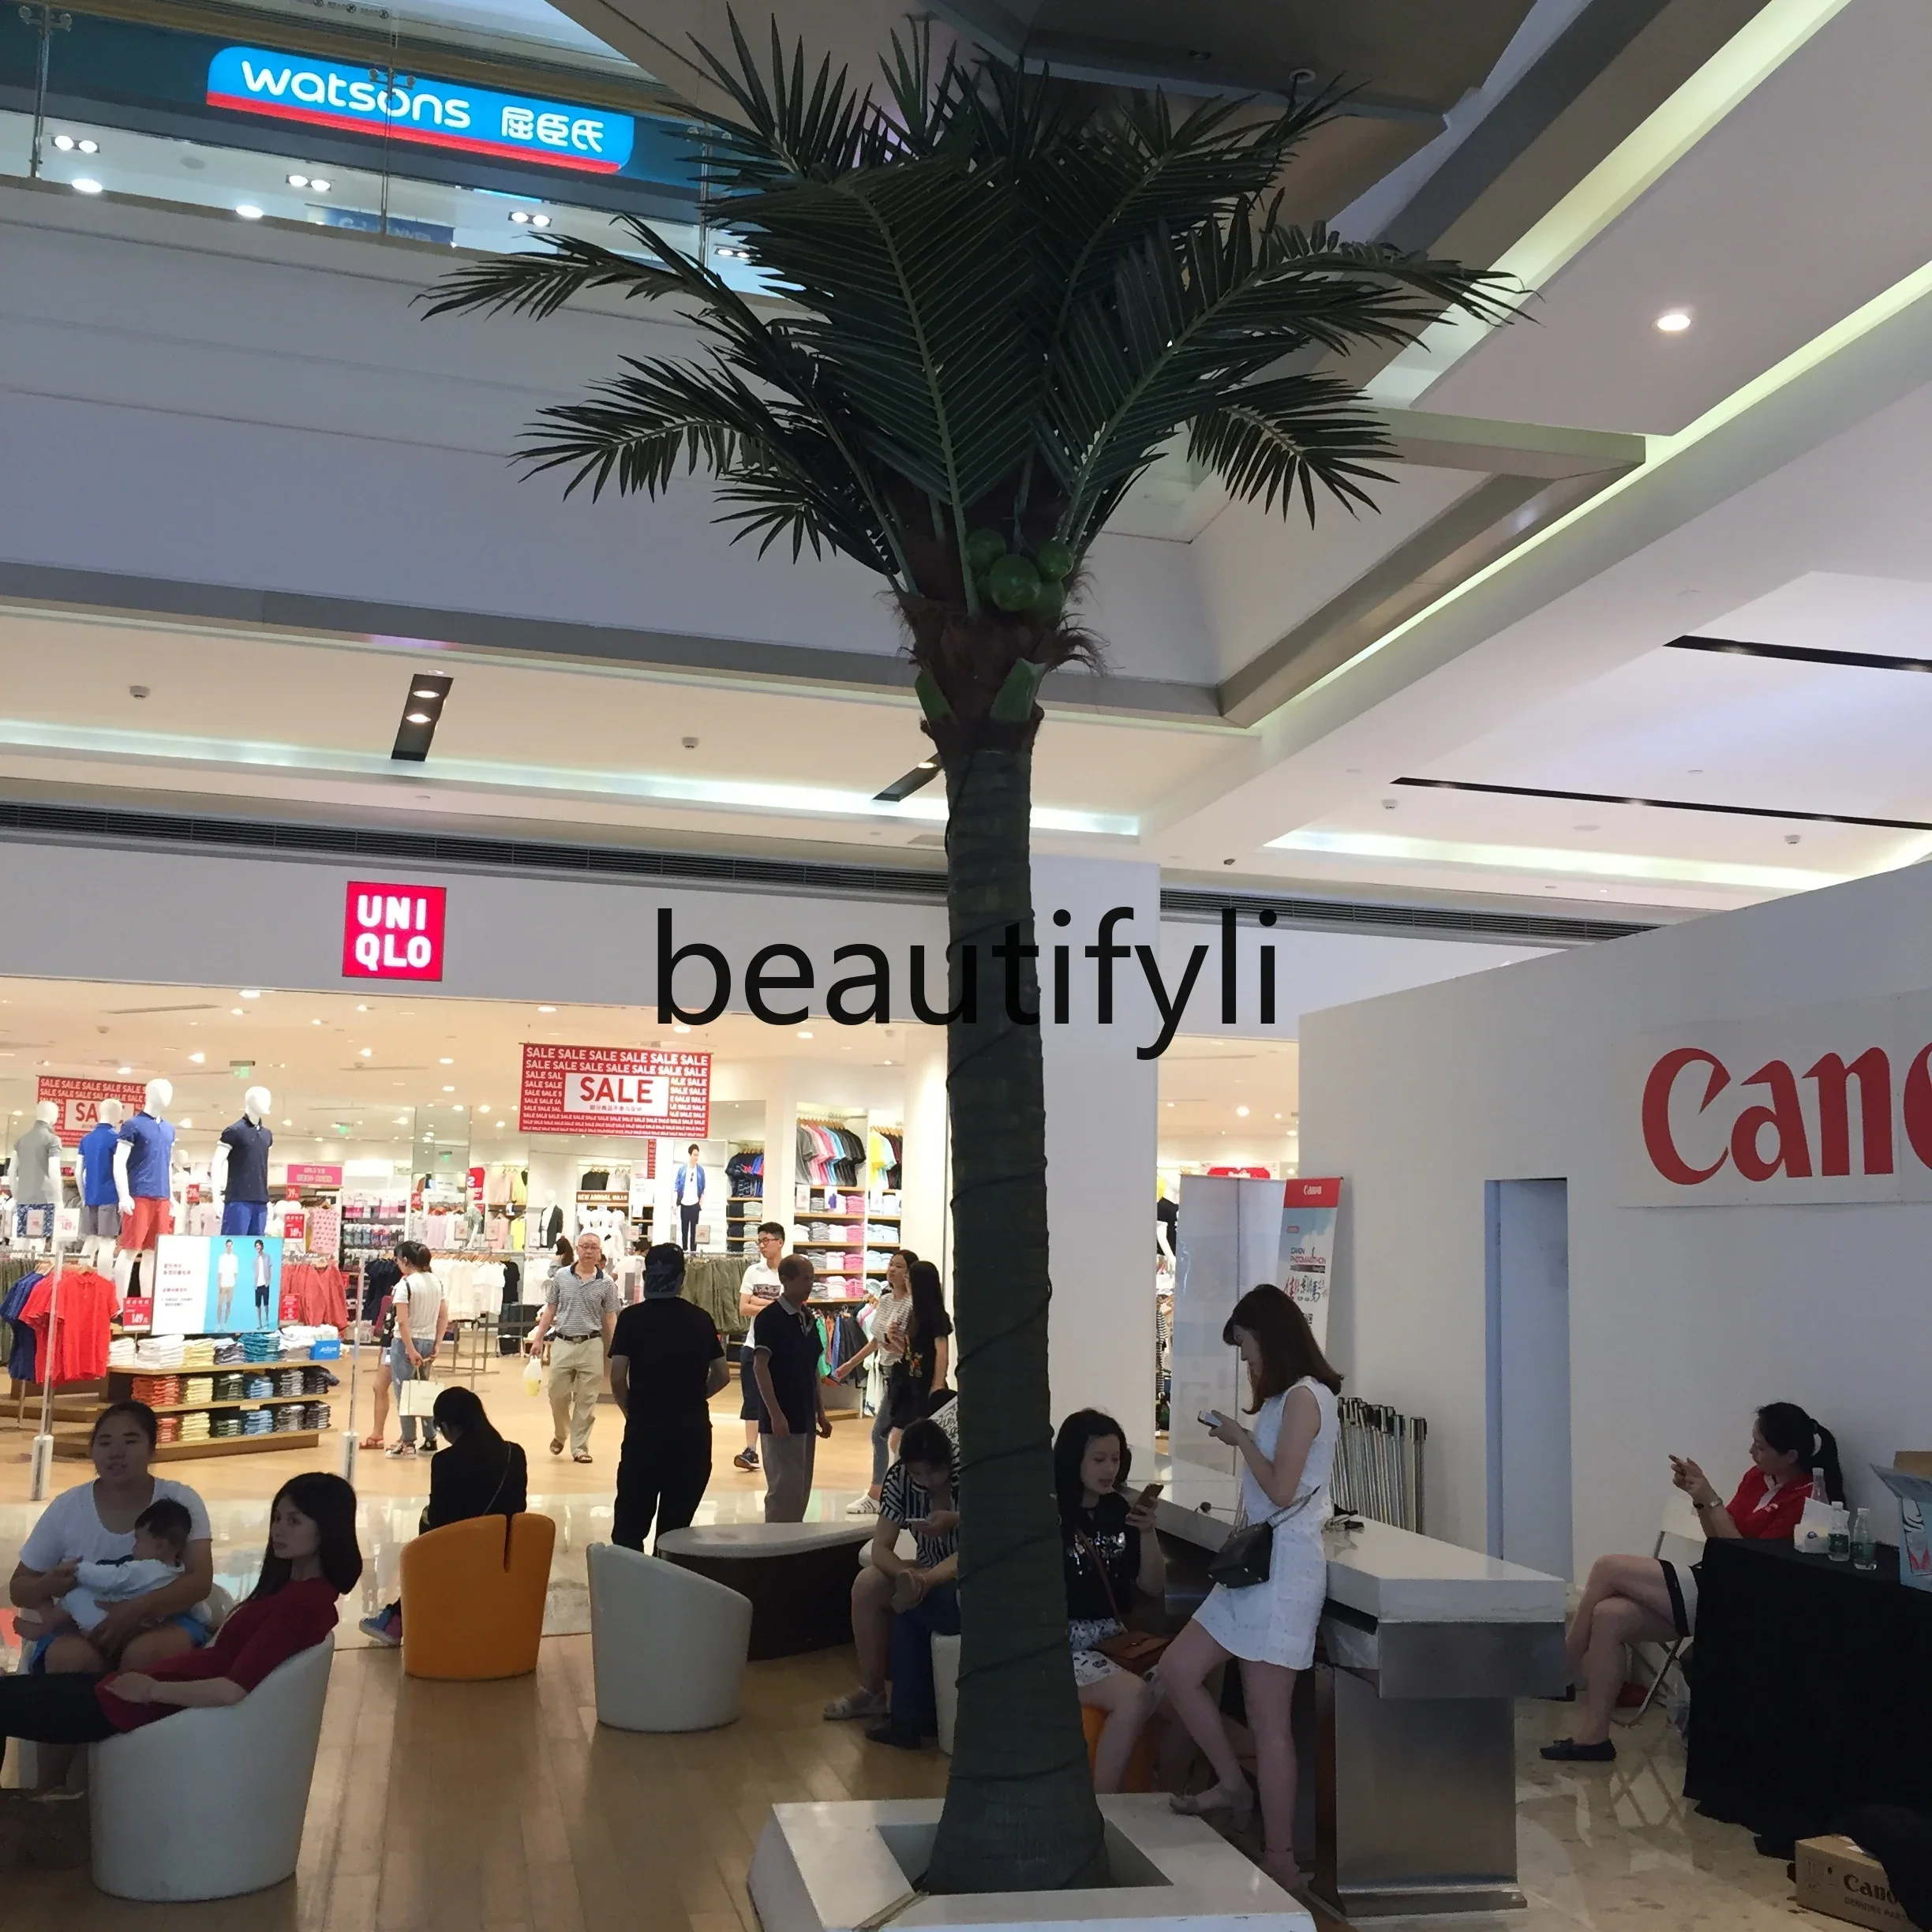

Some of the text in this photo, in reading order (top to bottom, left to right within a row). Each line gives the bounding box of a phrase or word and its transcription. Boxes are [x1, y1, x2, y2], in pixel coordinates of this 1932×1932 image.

[241, 60, 471, 129] watsons
[501, 106, 605, 153] 屈臣氏
[358, 894, 427, 930] UNI
[355, 932, 432, 972] QLO
[526, 1047, 708, 1065] SALE SALE SALE SALE SALE SALE
[526, 1060, 707, 1076] SALE SALE SALE SALE SALE SALE SALE
[39, 1088, 57, 1096] SALE
[128, 1094, 142, 1103] SALE
[40, 1078, 142, 1094] SALE SALE SALE SALE SALE
[579, 1076, 653, 1103] SALE
